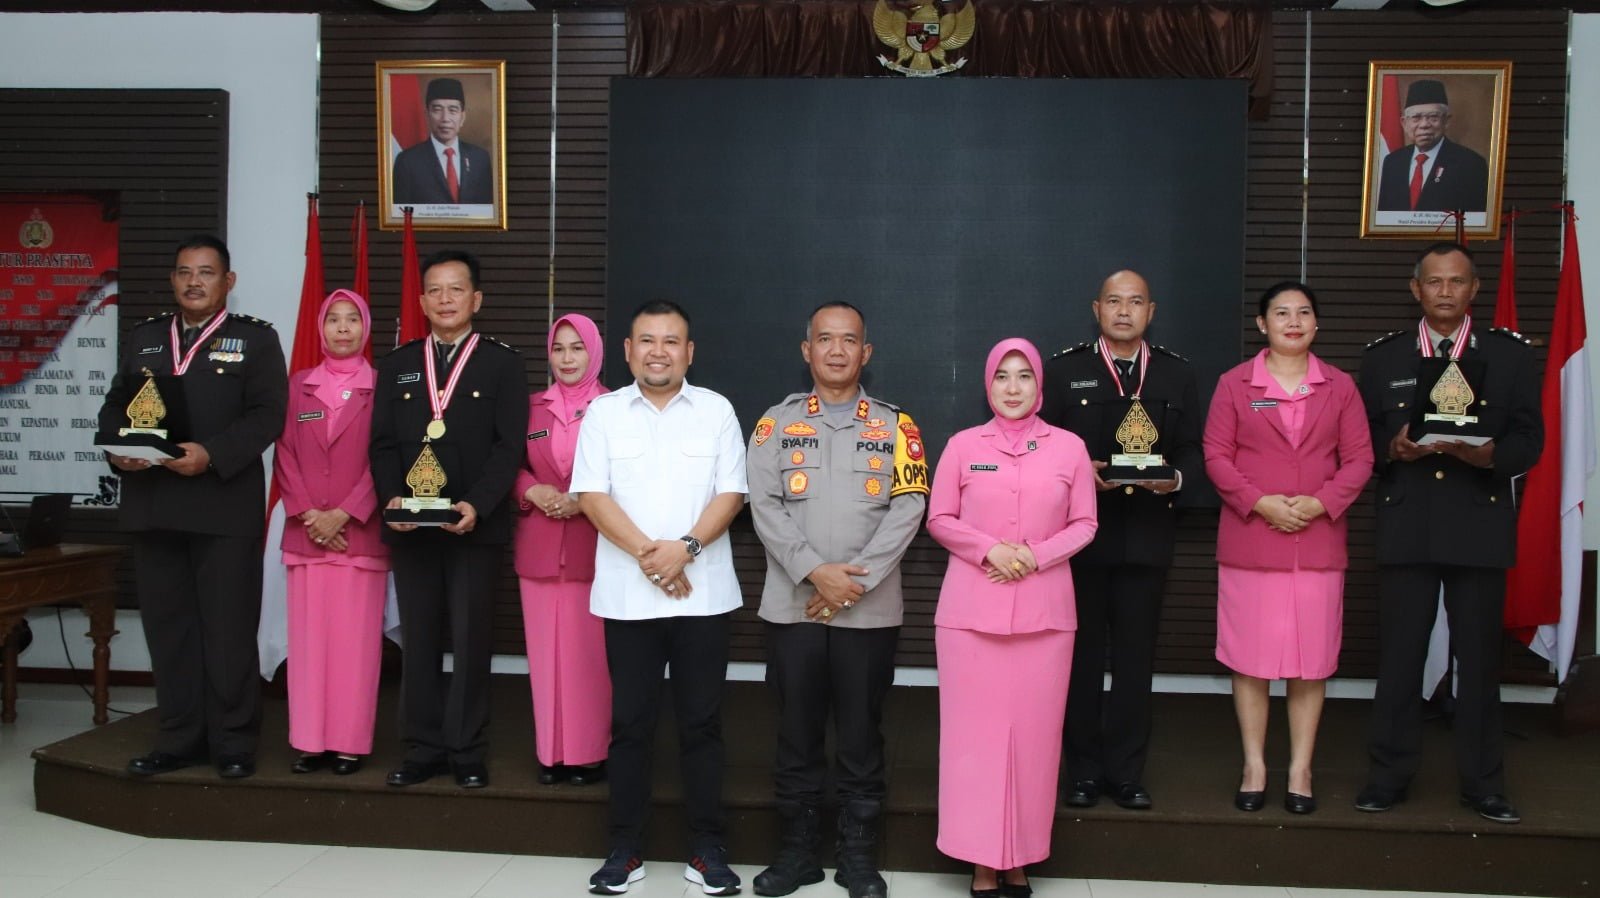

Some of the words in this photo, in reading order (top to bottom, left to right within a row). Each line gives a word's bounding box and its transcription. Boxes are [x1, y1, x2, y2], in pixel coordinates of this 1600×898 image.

[27, 253, 93, 269] PRASETYA
[77, 337, 106, 348] BENTUK
[23, 369, 74, 380] SELAMATAN
[88, 370, 106, 380] JIWA
[35, 384, 58, 395] BENDA
[66, 384, 80, 395] DAN
[89, 385, 105, 395] HAK
[21, 417, 58, 428] KEPASTIAN
[71, 418, 98, 429] BERDAS
[781, 437, 819, 449] SYAFI'I
[856, 441, 893, 455] POLRI
[29, 450, 65, 461] PERASAAN
[892, 465, 901, 489] A
[903, 463, 926, 486] OPS
